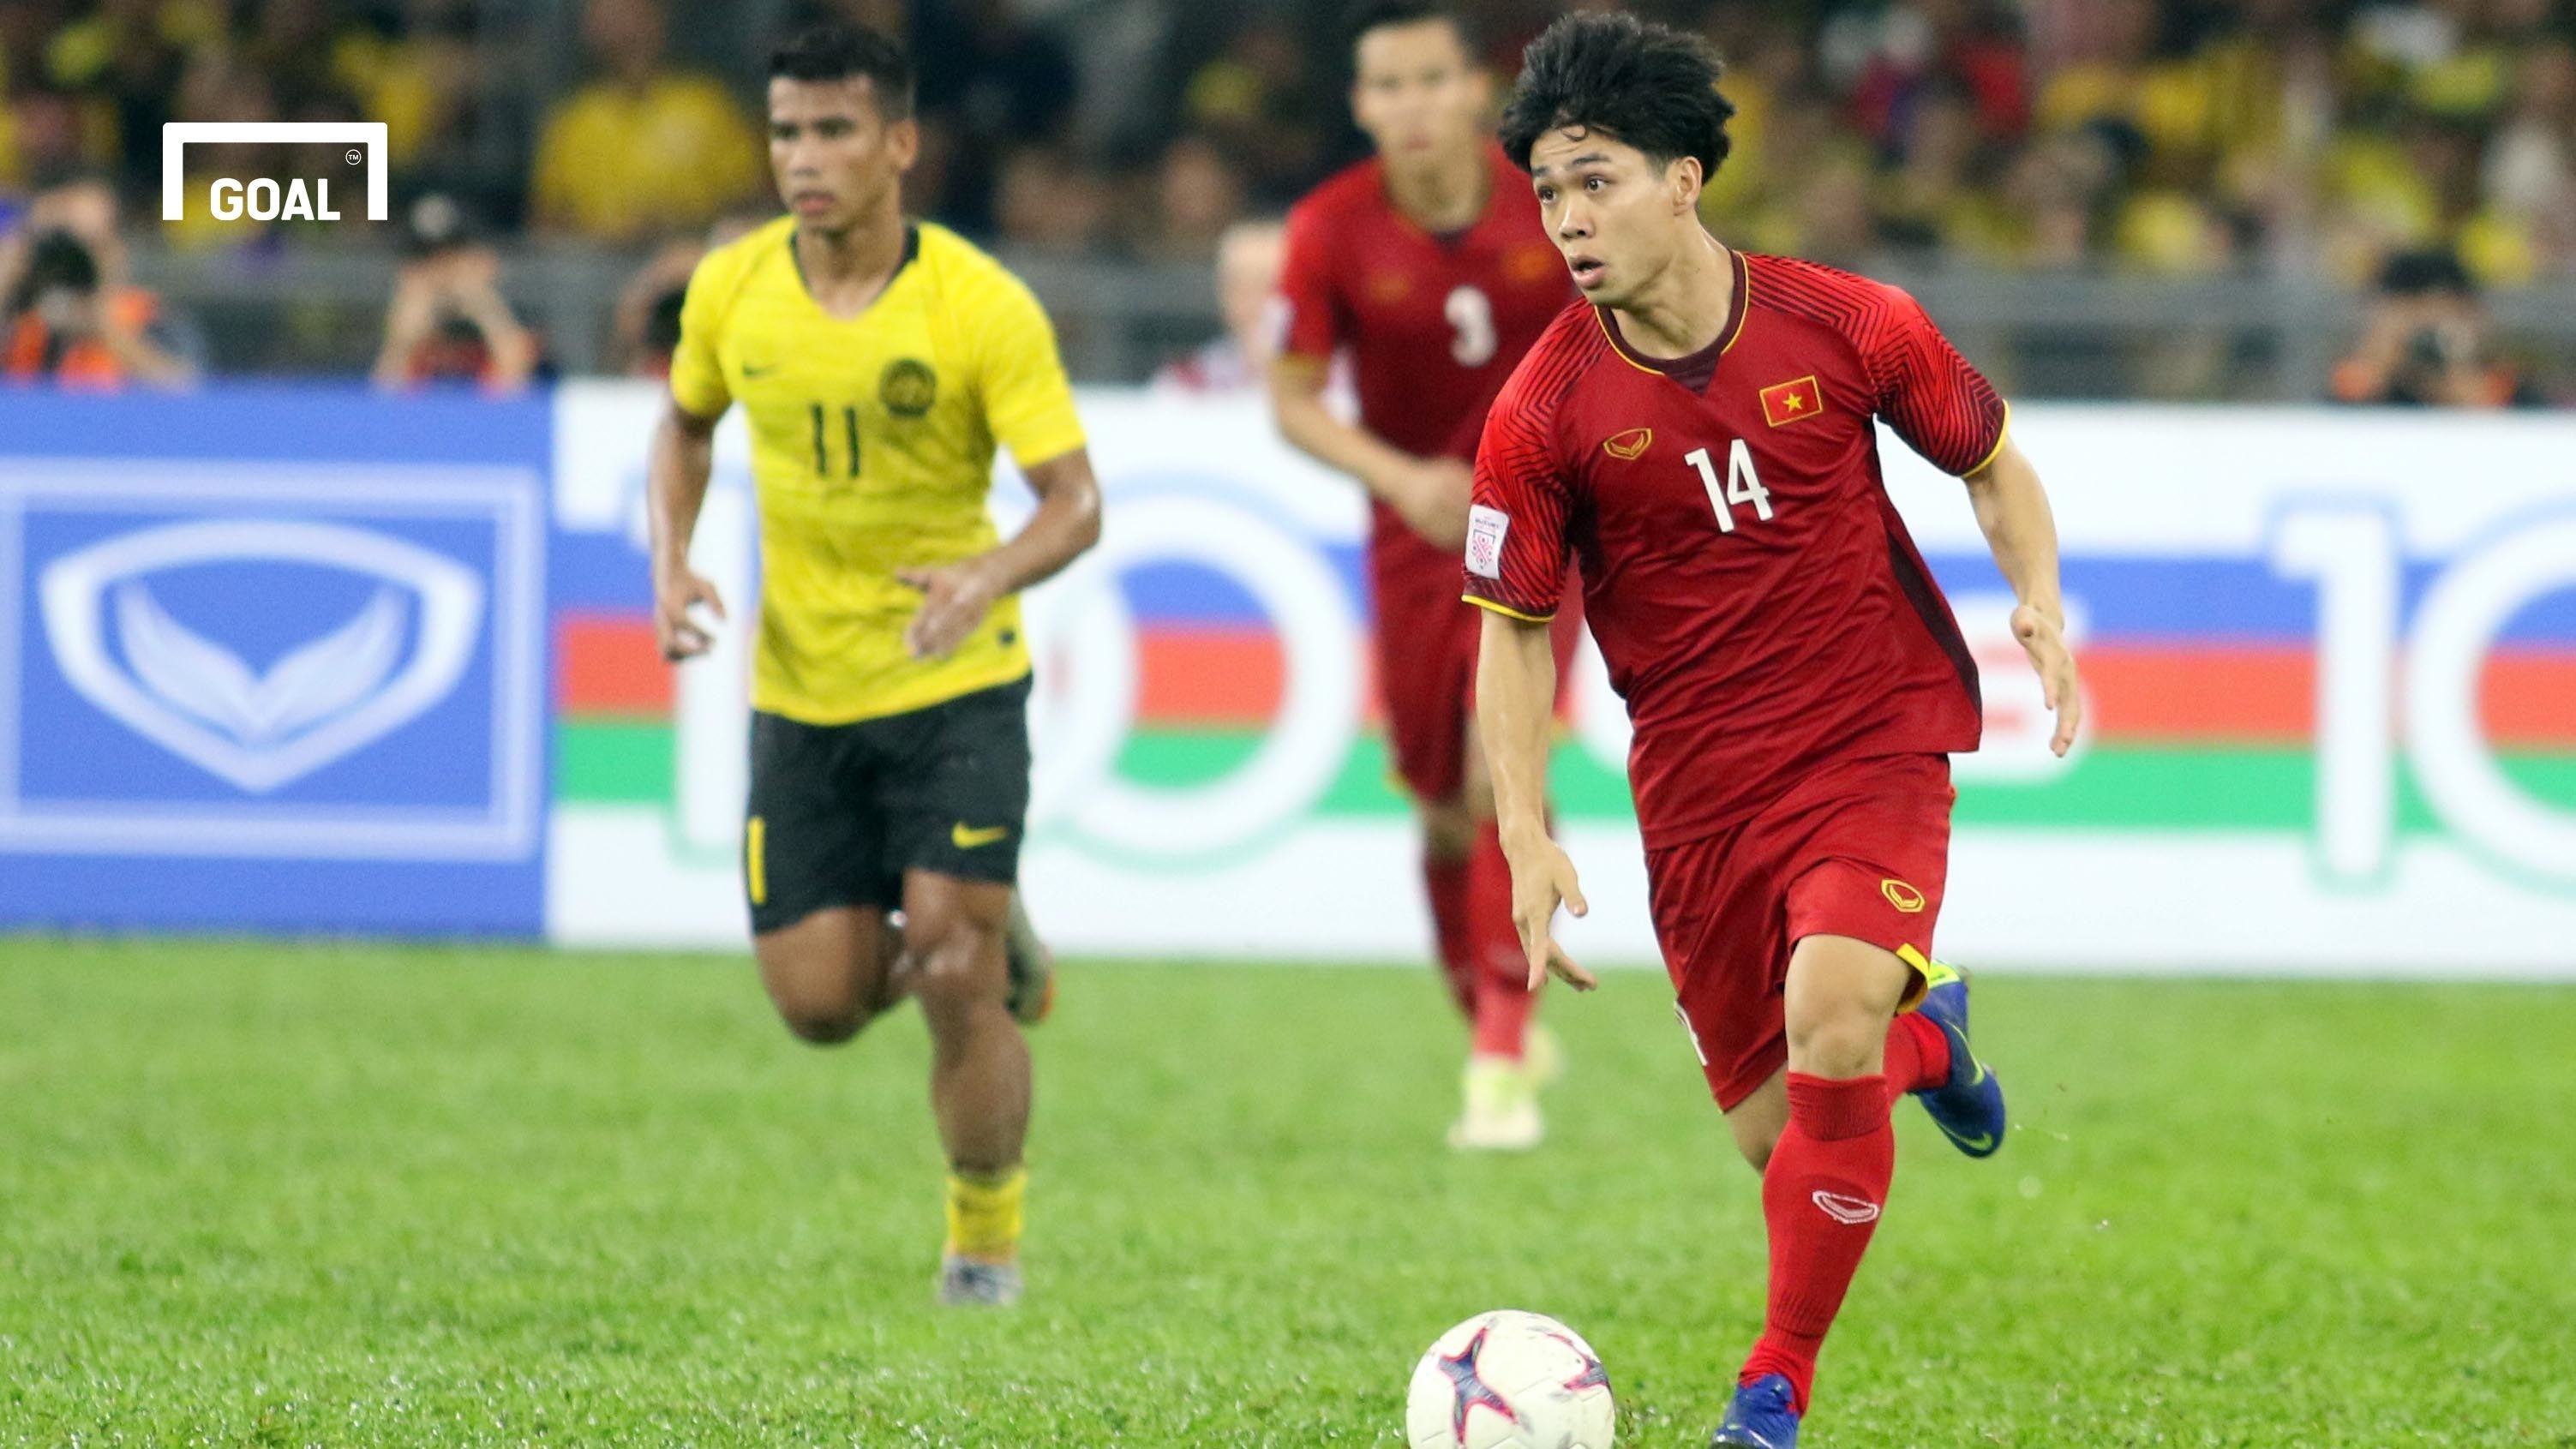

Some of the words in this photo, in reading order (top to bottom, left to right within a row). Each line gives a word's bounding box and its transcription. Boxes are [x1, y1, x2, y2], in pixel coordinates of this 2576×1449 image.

[1444, 284, 1497, 368] 3
[810, 404, 861, 477] 11
[1684, 438, 1774, 533] 14
